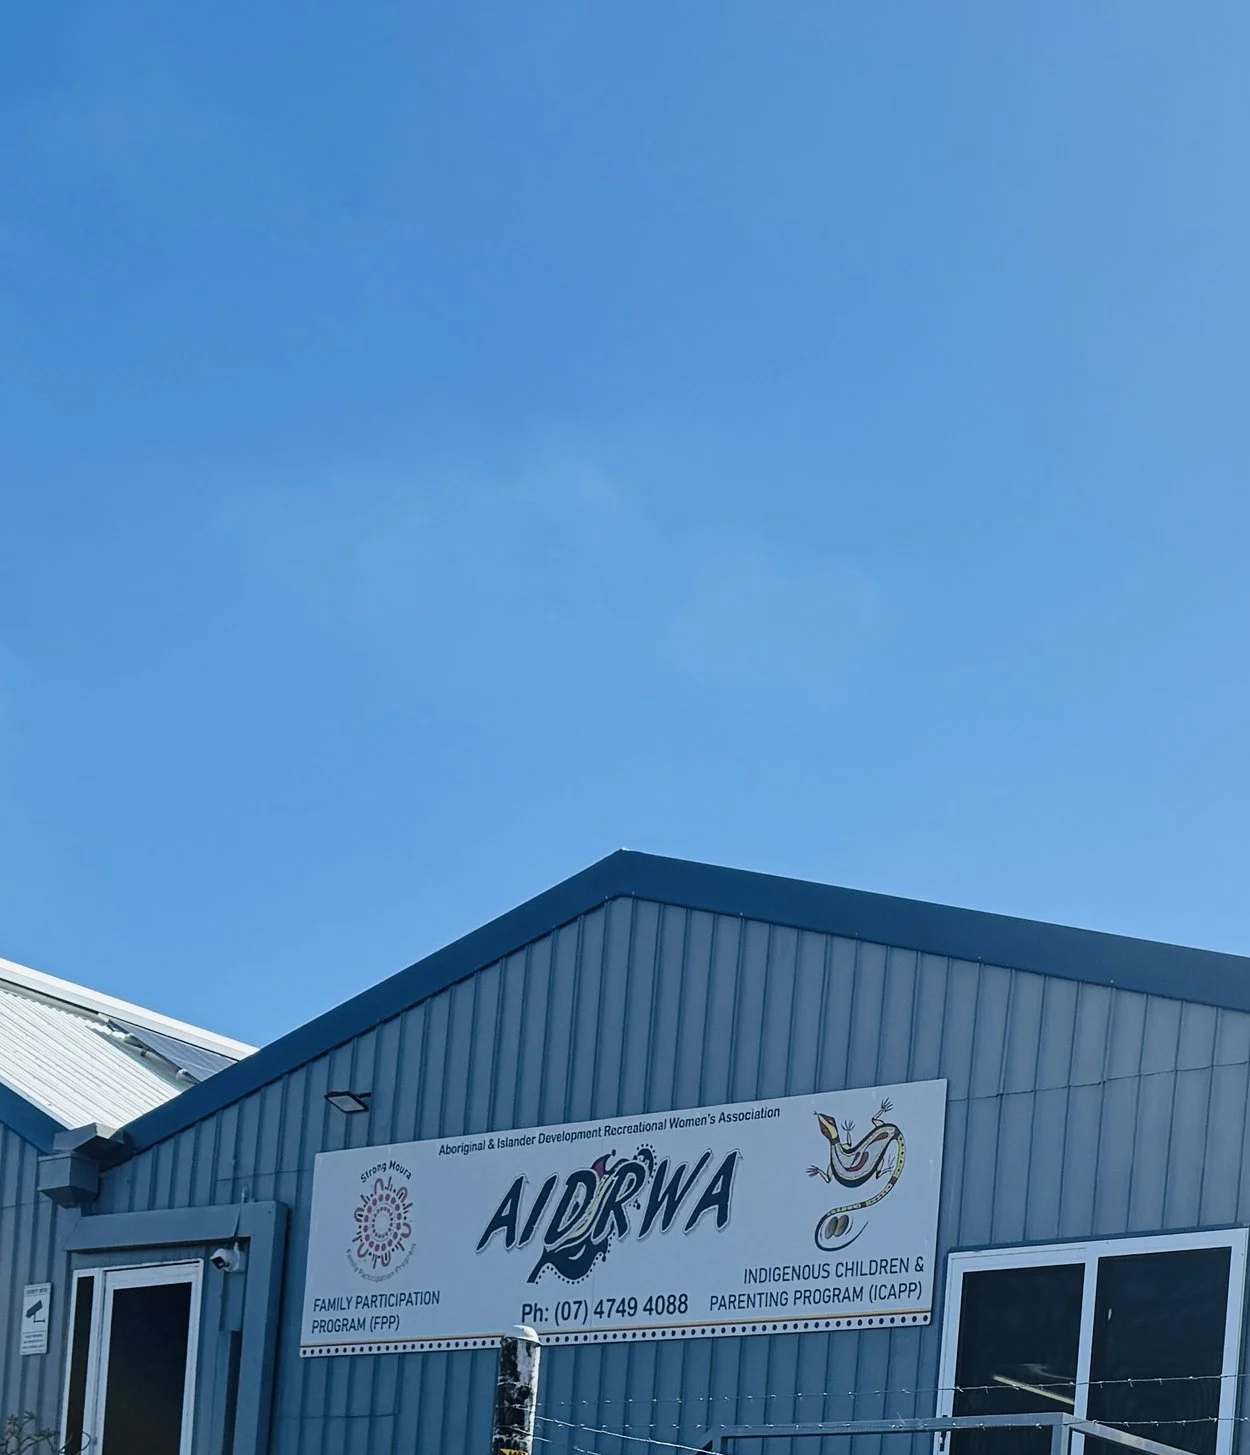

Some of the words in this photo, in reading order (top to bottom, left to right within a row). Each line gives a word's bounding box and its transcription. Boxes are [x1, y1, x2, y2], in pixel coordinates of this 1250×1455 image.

[438, 1138, 486, 1156] Aboriginal
[487, 1138, 496, 1151] &
[497, 1134, 536, 1149] Islander
[538, 1126, 602, 1144] Development
[603, 1118, 667, 1137] Recreational
[669, 1113, 716, 1130] Women's
[718, 1107, 781, 1124] Association
[360, 1162, 387, 1184] Strong
[389, 1159, 412, 1181] Moura
[475, 1147, 743, 1254] AIDRWA
[743, 1262, 831, 1285] INDIGENOUS
[834, 1257, 910, 1279] CHILDREN
[913, 1255, 925, 1273] &
[313, 1295, 353, 1313] FAMILY
[354, 1289, 440, 1310] PARTICIPATION
[521, 1302, 549, 1324] Ph:
[554, 1299, 589, 1327] (07)
[593, 1296, 638, 1319] 4749
[642, 1292, 689, 1316] 4088
[709, 1290, 789, 1312] PARENTING
[793, 1286, 864, 1307] PROGRAM
[868, 1280, 923, 1304] (ICAPP)
[311, 1316, 366, 1334] PROGRAM
[369, 1314, 401, 1333] (FPP)
